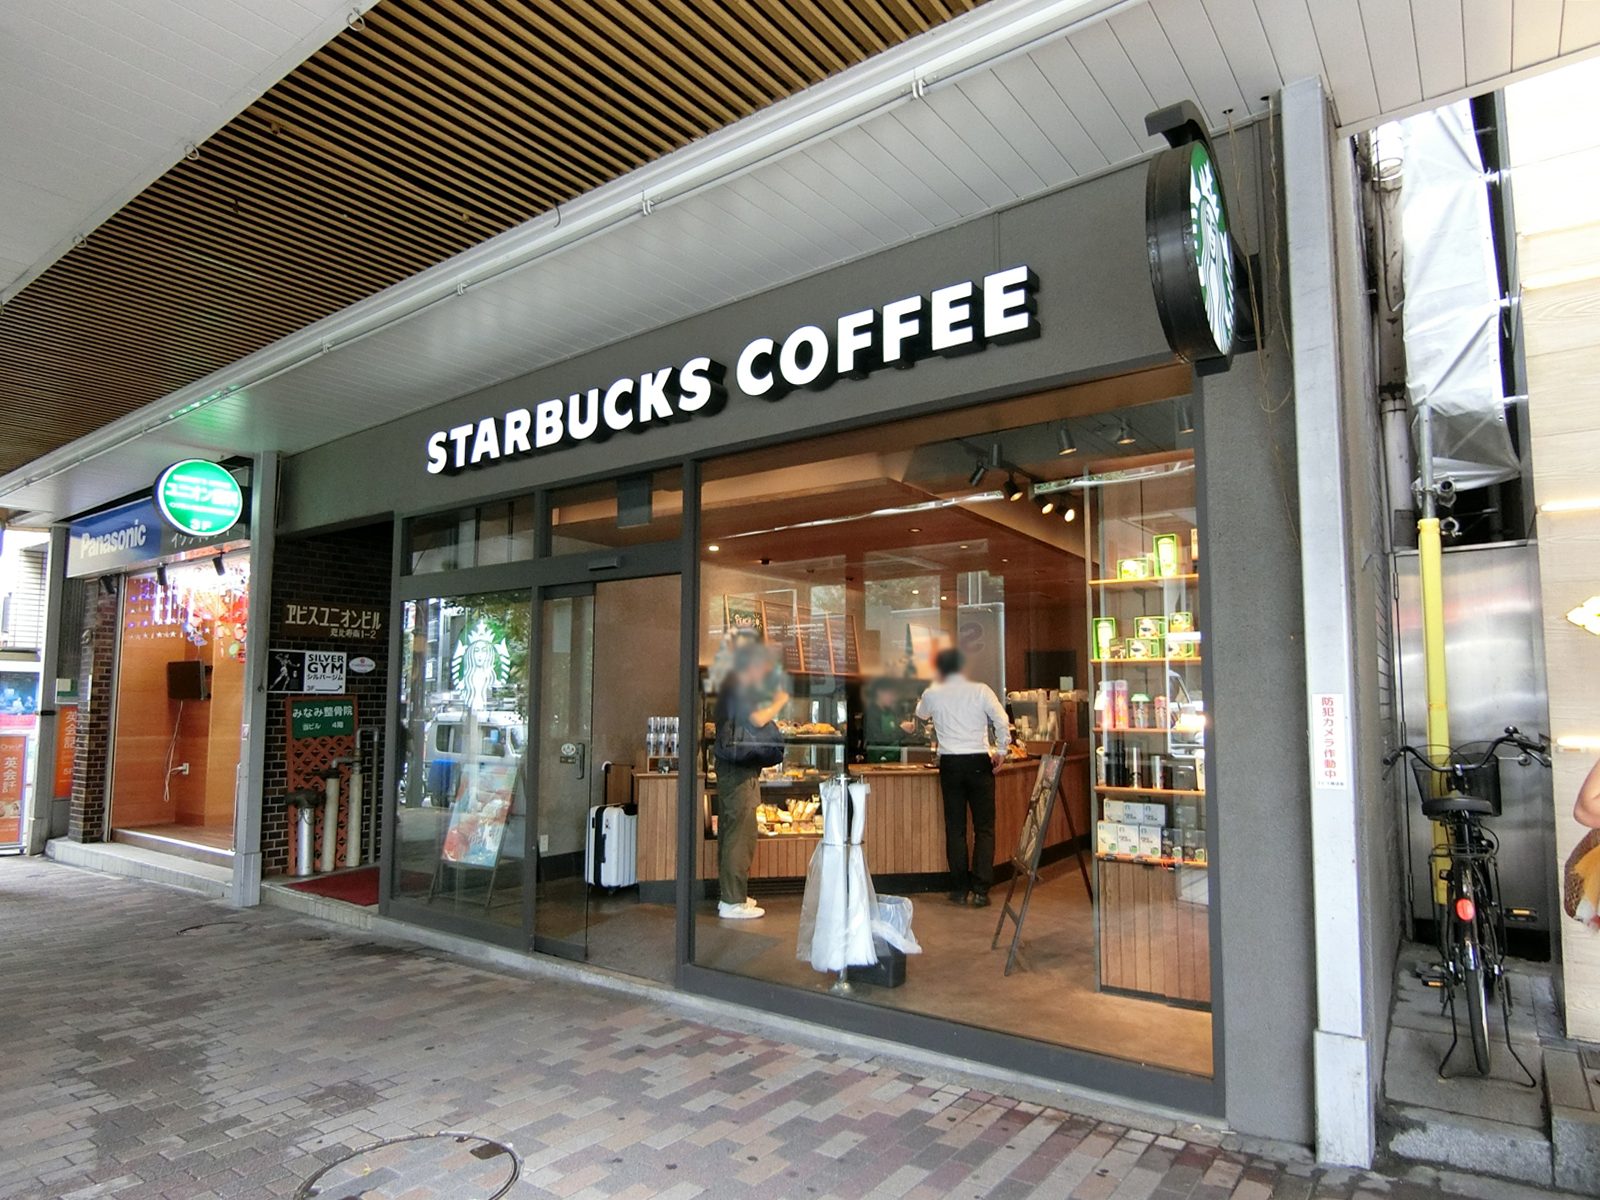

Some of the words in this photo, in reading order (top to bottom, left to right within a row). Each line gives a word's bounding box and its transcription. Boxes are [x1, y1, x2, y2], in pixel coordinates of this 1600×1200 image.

[426, 357, 713, 475] STARBUCKS
[735, 265, 1030, 397] COFFEE
[190, 518, 212, 531] 3F
[80, 519, 147, 559] Panasonic
[308, 653, 344, 663] SILVER
[307, 662, 343, 674] GYM
[307, 673, 343, 681] シルバージム
[292, 705, 353, 718] みなみ整骨院
[1321, 697, 1336, 779] 防犯カメラ作動中
